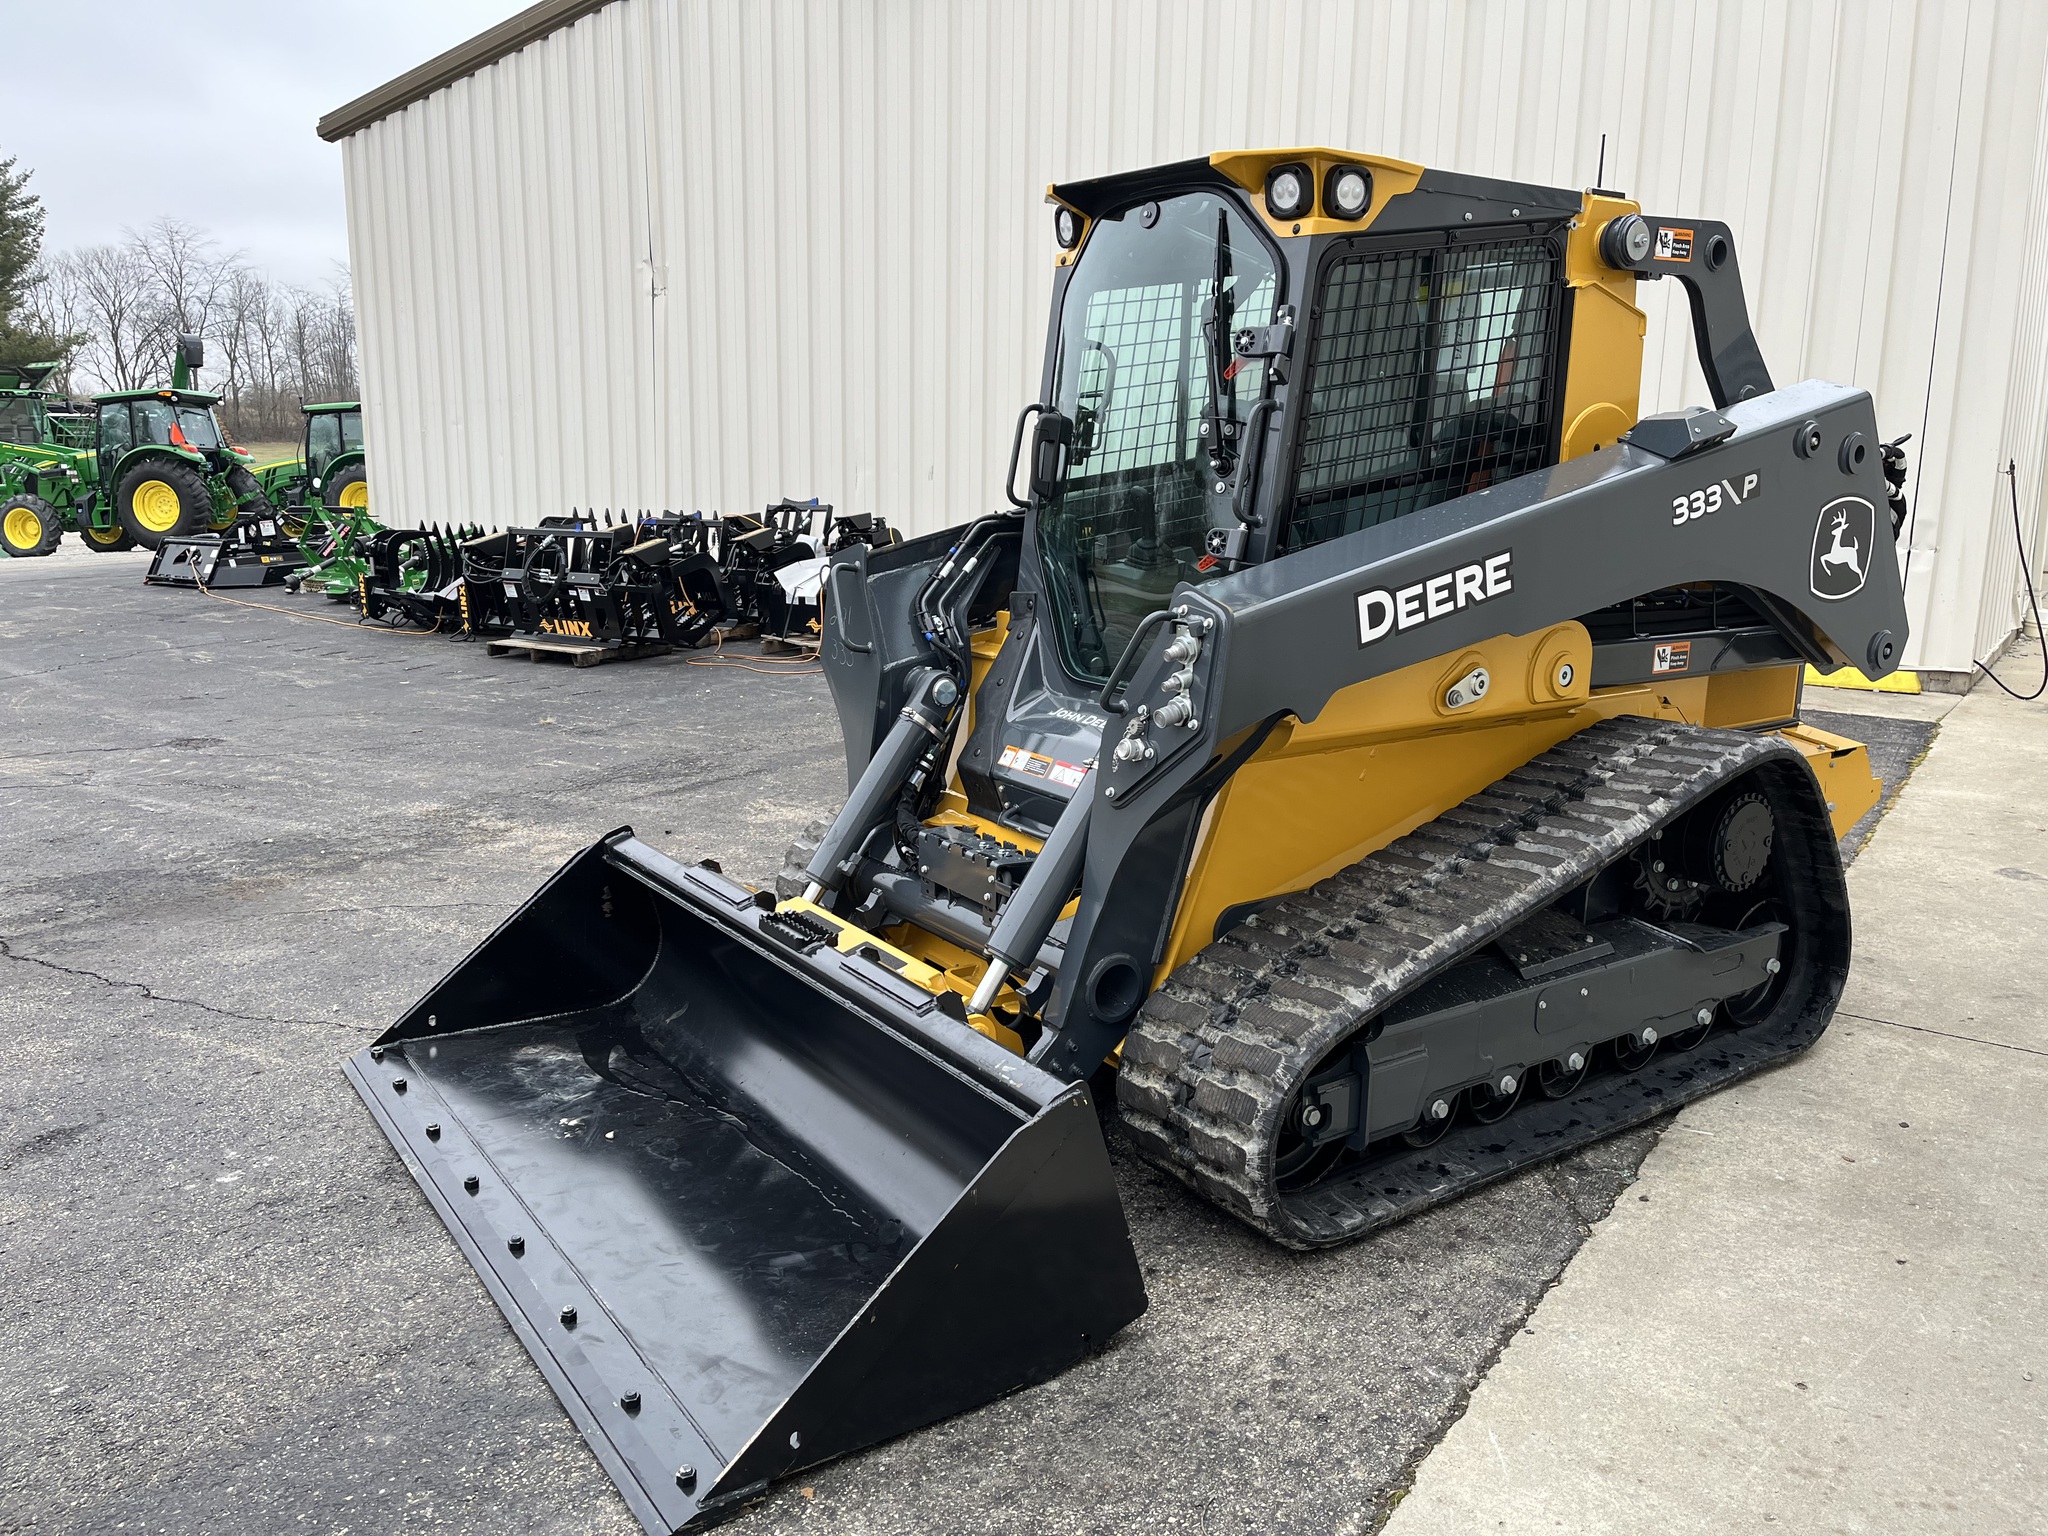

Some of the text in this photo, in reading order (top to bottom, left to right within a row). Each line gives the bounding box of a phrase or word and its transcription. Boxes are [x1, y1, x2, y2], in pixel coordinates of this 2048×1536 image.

[358, 572, 367, 604] LINX
[458, 585, 469, 618] LINX
[1357, 552, 1513, 645] DEERE
[553, 619, 594, 637] LINX
[1048, 707, 1084, 722] JOHN
